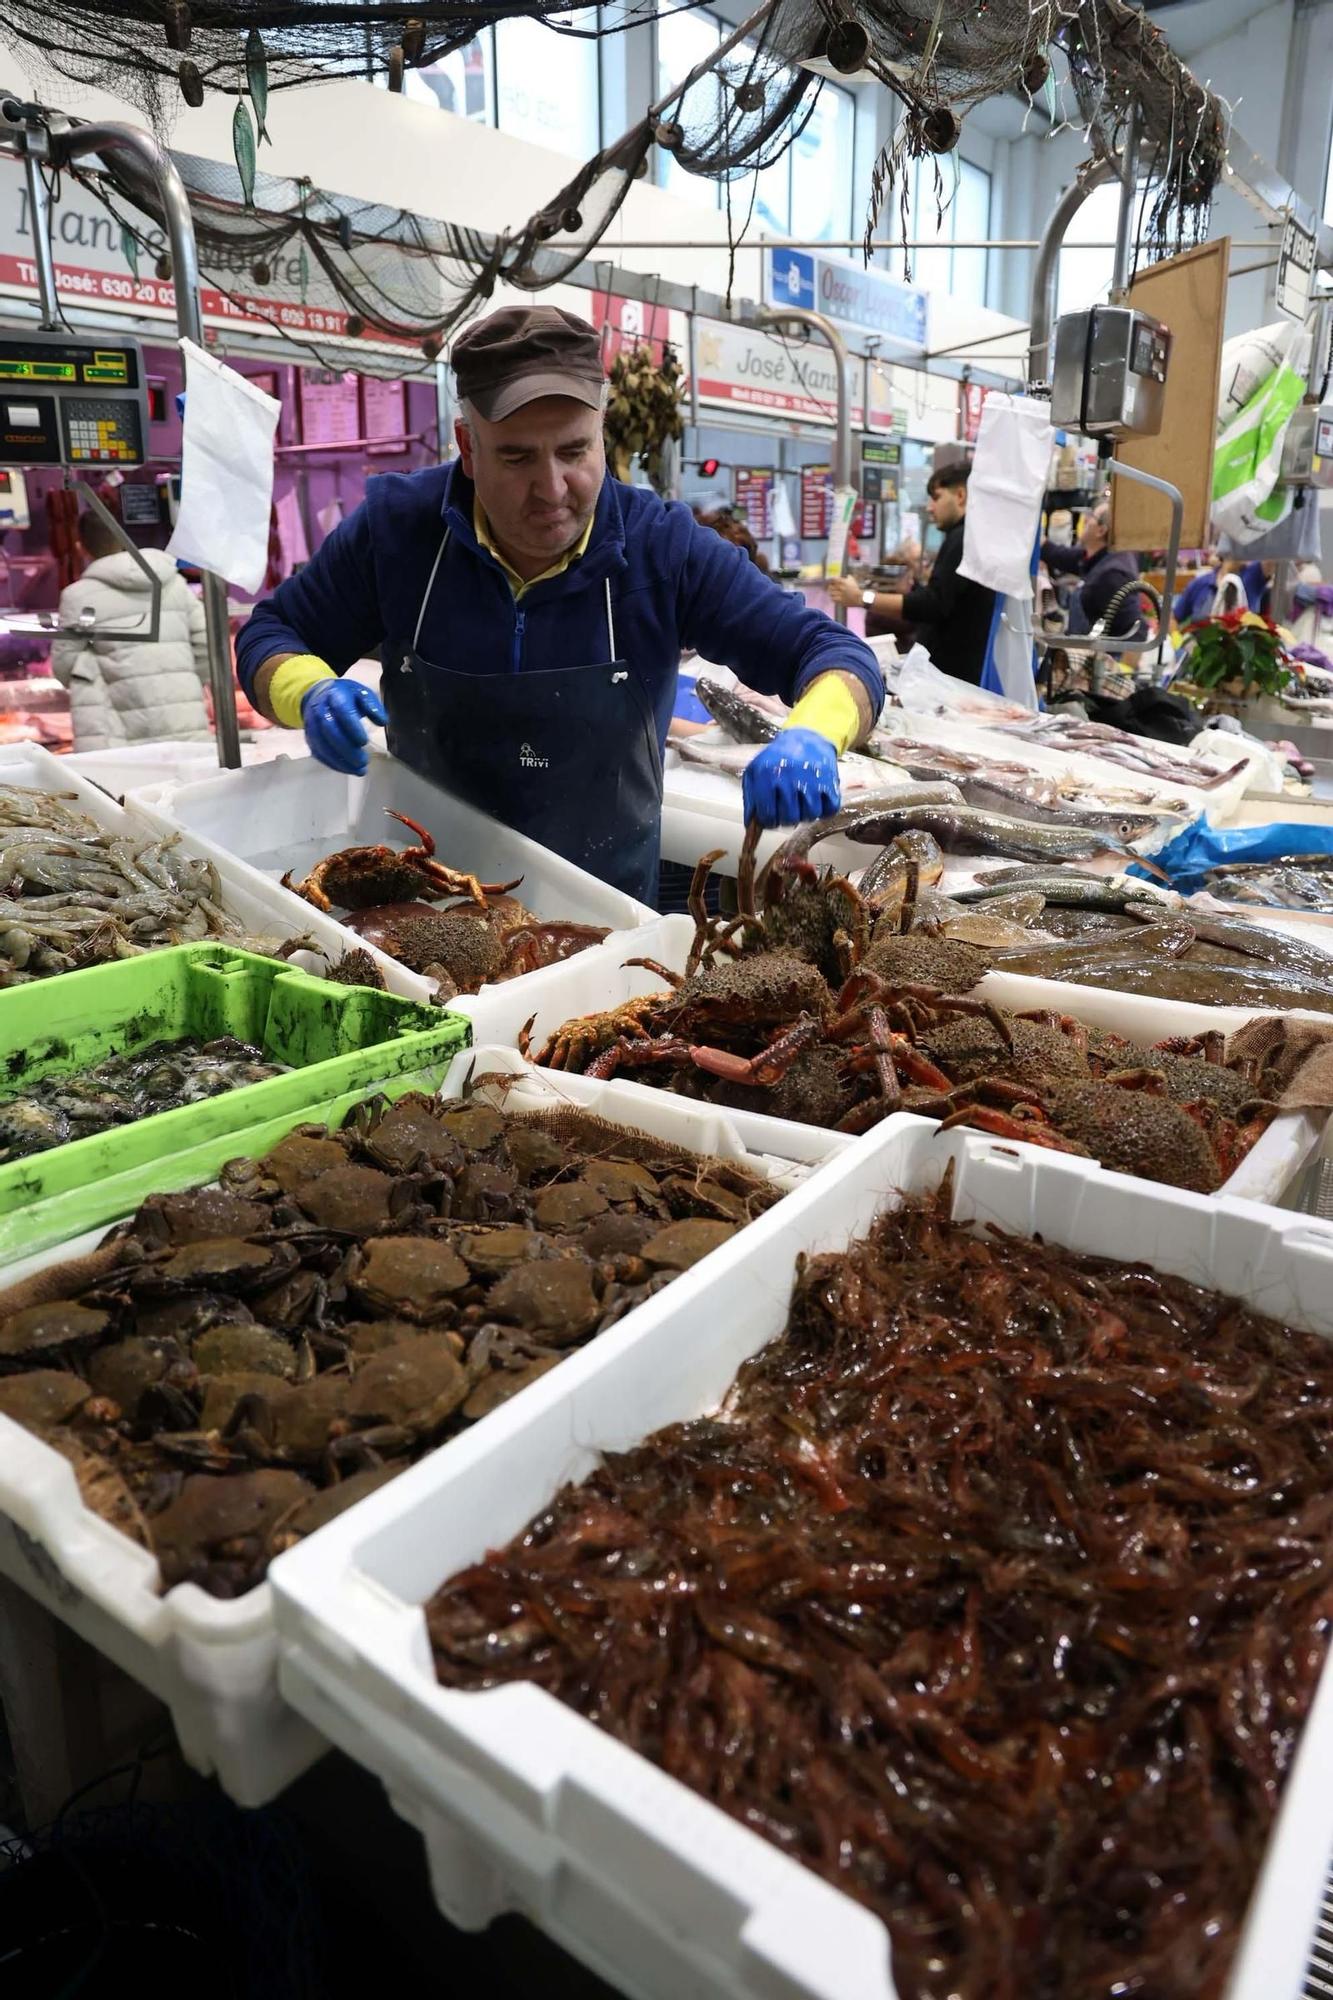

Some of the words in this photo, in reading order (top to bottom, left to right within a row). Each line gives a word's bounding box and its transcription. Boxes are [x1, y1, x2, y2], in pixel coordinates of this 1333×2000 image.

[101, 278, 133, 299] 630
[135, 283, 156, 303] 20
[737, 348, 786, 382] José
